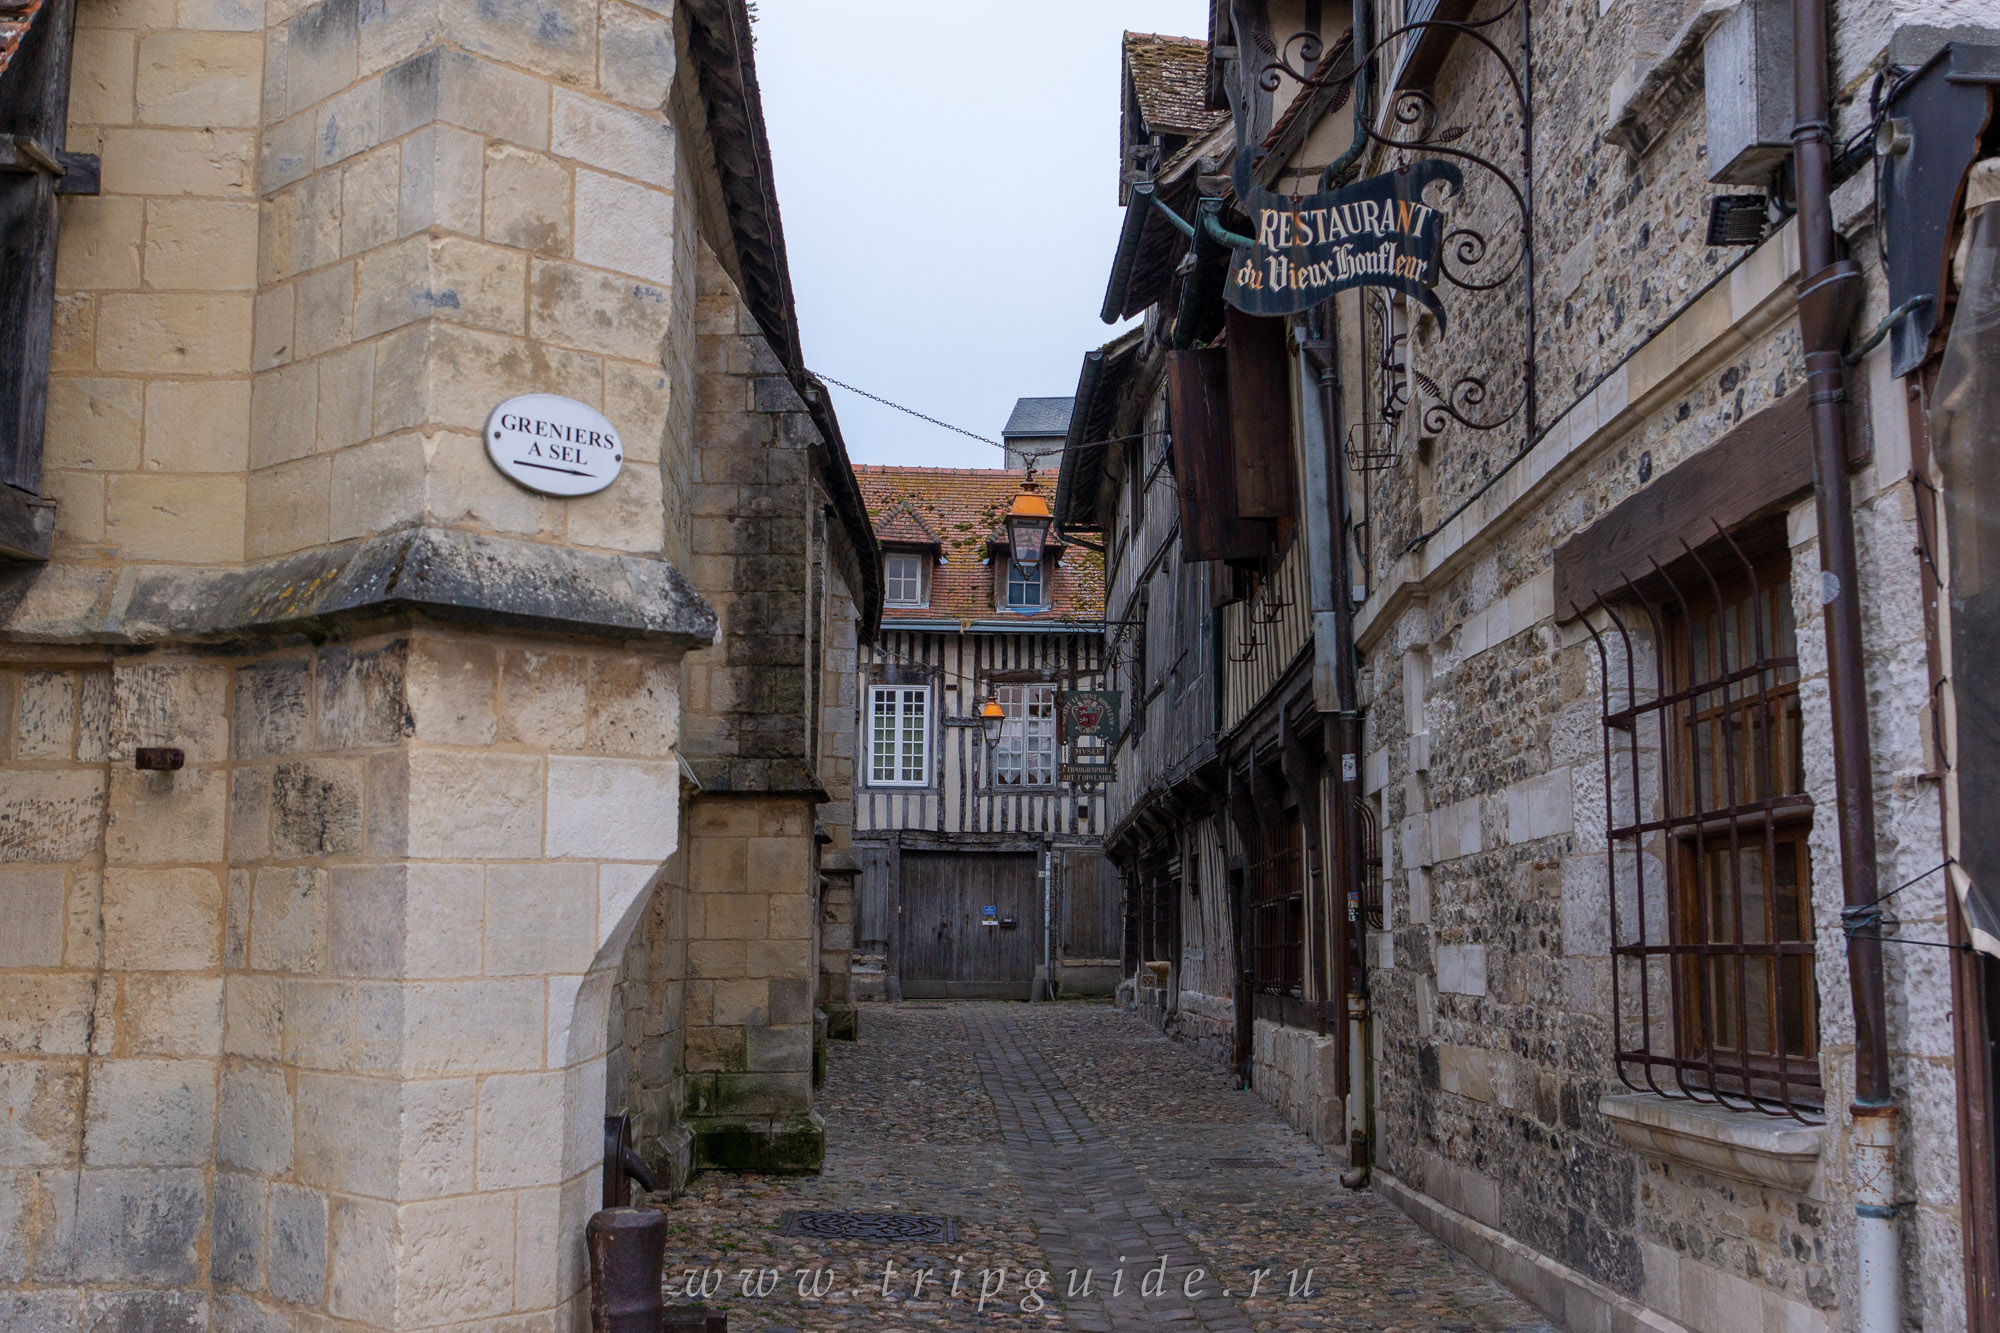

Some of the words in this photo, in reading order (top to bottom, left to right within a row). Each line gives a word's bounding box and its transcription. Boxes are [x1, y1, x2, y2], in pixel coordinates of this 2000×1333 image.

[1258, 198, 1432, 252] RESTAURANT
[1236, 259, 1263, 291] du
[1265, 255, 1336, 293] Vieux
[1333, 240, 1428, 285] Honfleur
[501, 413, 615, 450] GRENIERS
[528, 441, 542, 457] A
[549, 444, 588, 465] SEL
